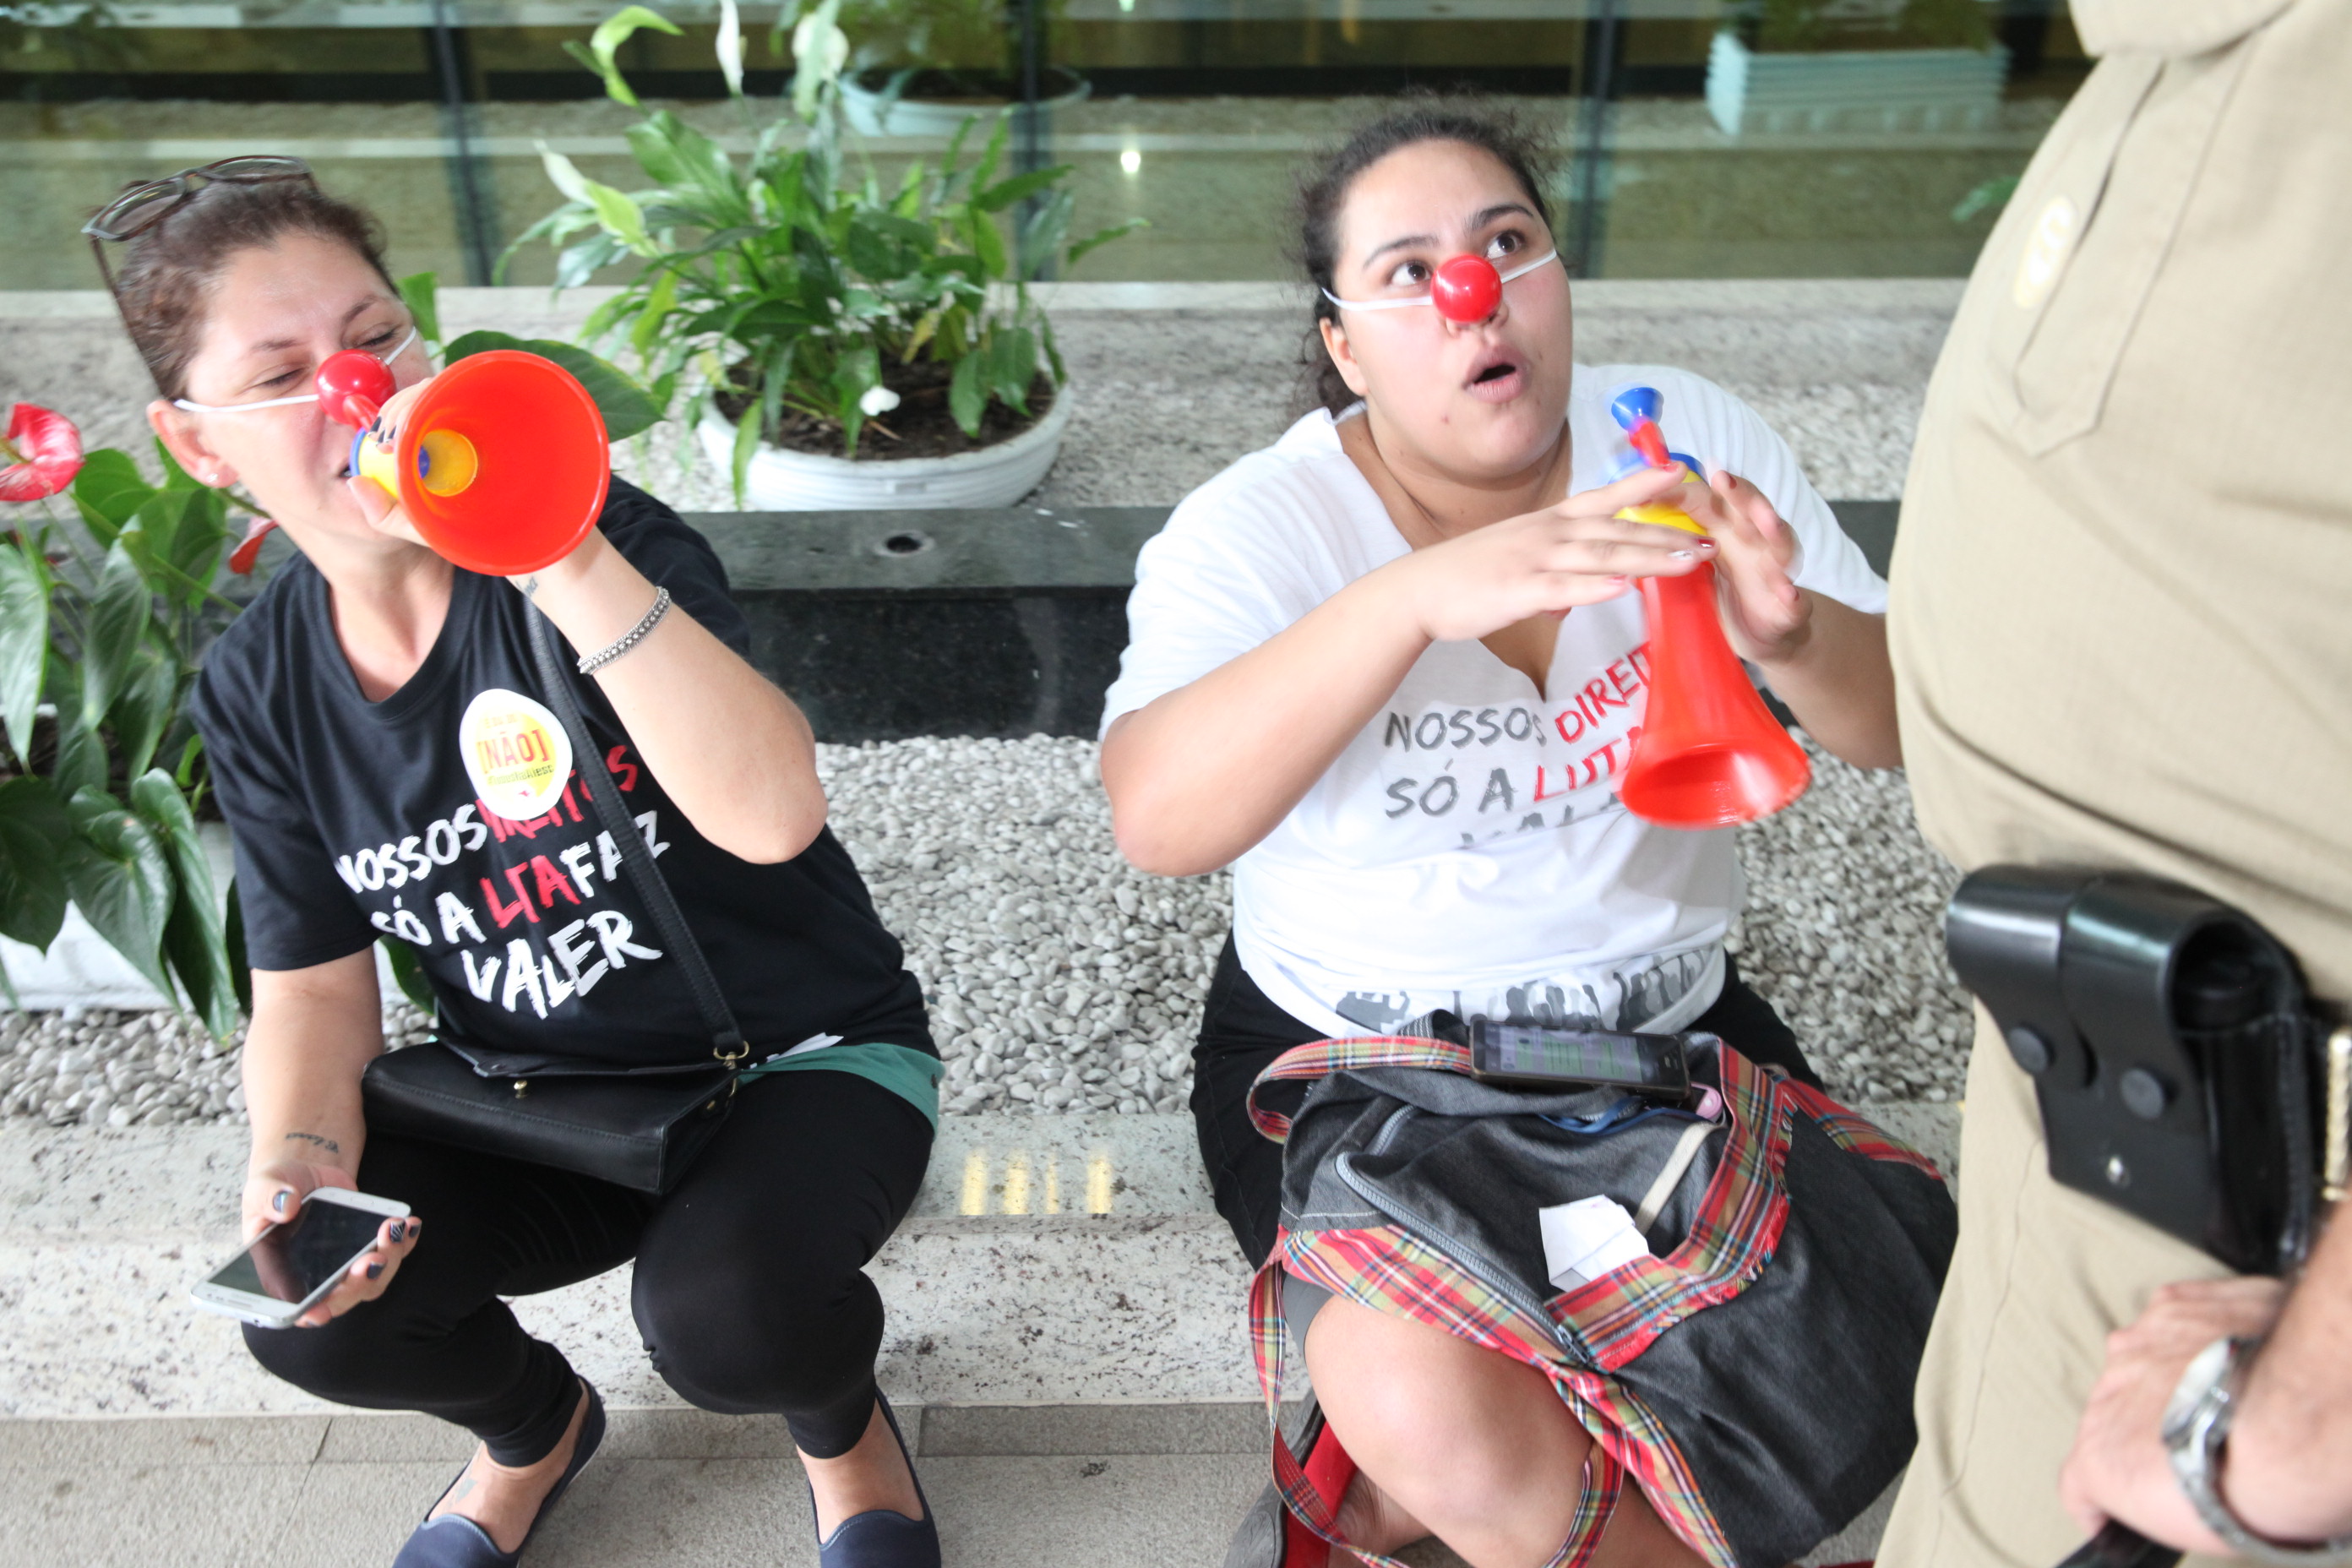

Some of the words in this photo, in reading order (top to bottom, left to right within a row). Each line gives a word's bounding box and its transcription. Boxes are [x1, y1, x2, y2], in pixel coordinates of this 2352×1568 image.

[1383, 706, 1548, 752] NOSSOS
[1385, 758, 1460, 819] SÓ
[1478, 767, 1516, 814] A
[435, 891, 487, 944] A
